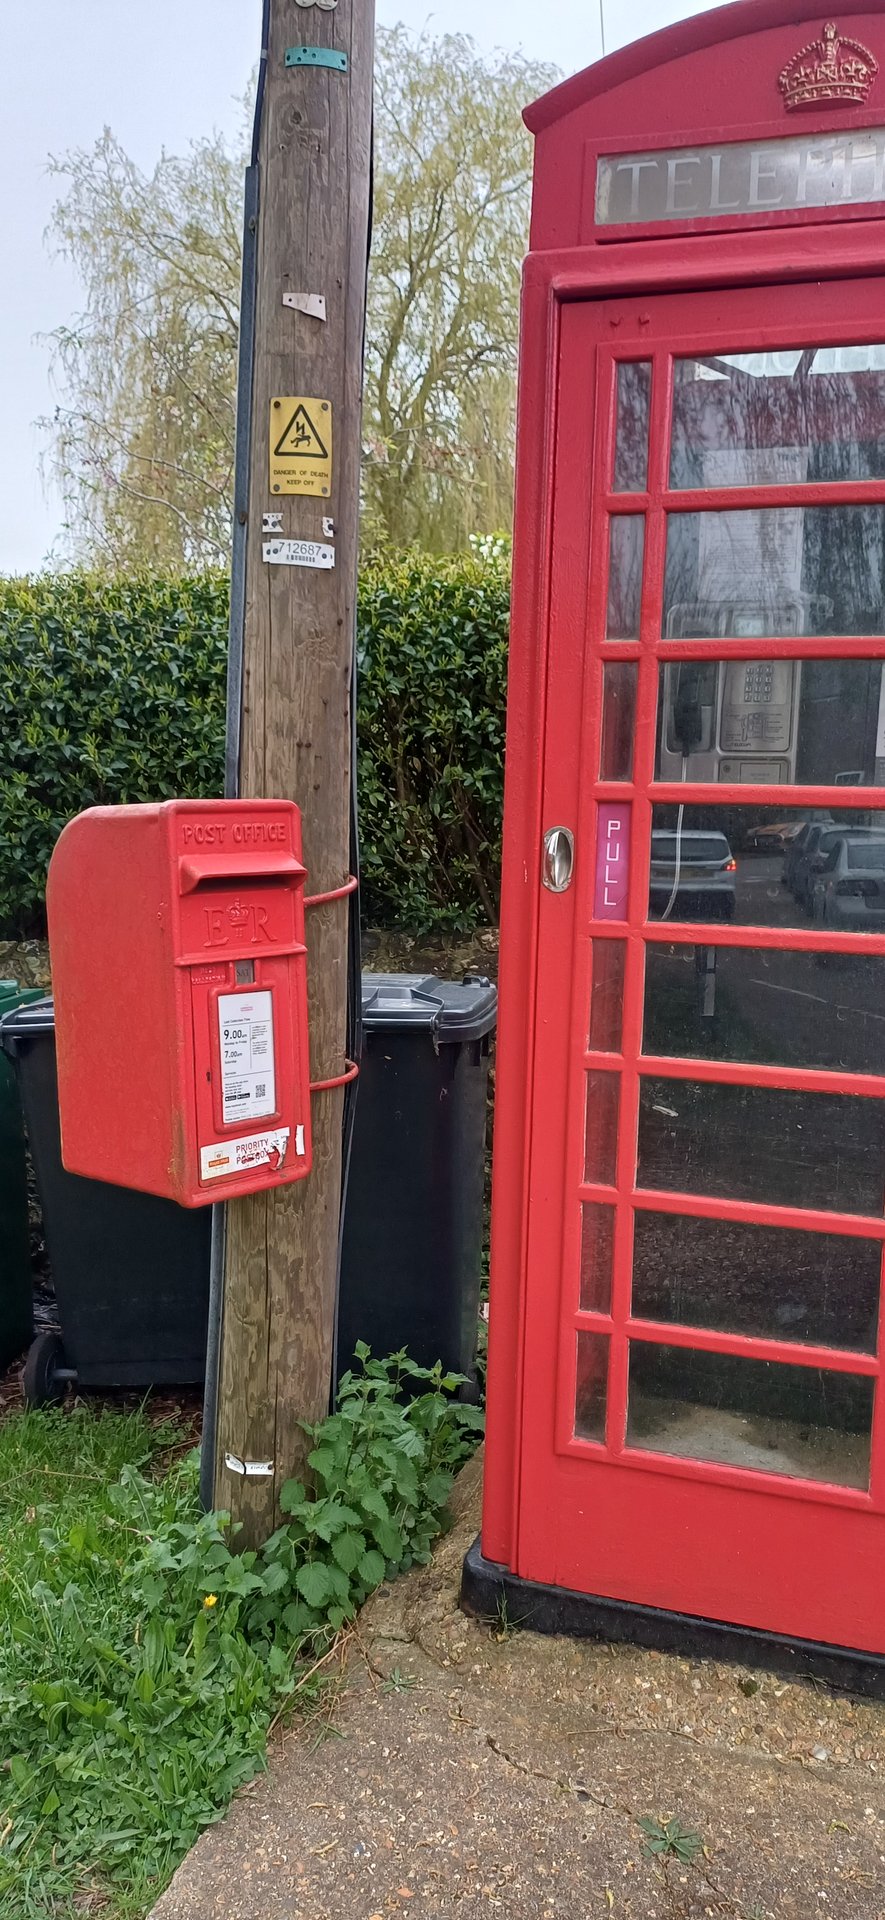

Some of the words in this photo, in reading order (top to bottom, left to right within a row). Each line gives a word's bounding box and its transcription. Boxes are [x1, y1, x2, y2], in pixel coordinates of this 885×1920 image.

[310, 470, 329, 478] DEATH
[278, 541, 322, 555] 712687
[182, 823, 226, 844] POST
[231, 822, 287, 843] OFFICE
[603, 820, 621, 906] PULL
[235, 1138, 269, 1153] PRIORITY
